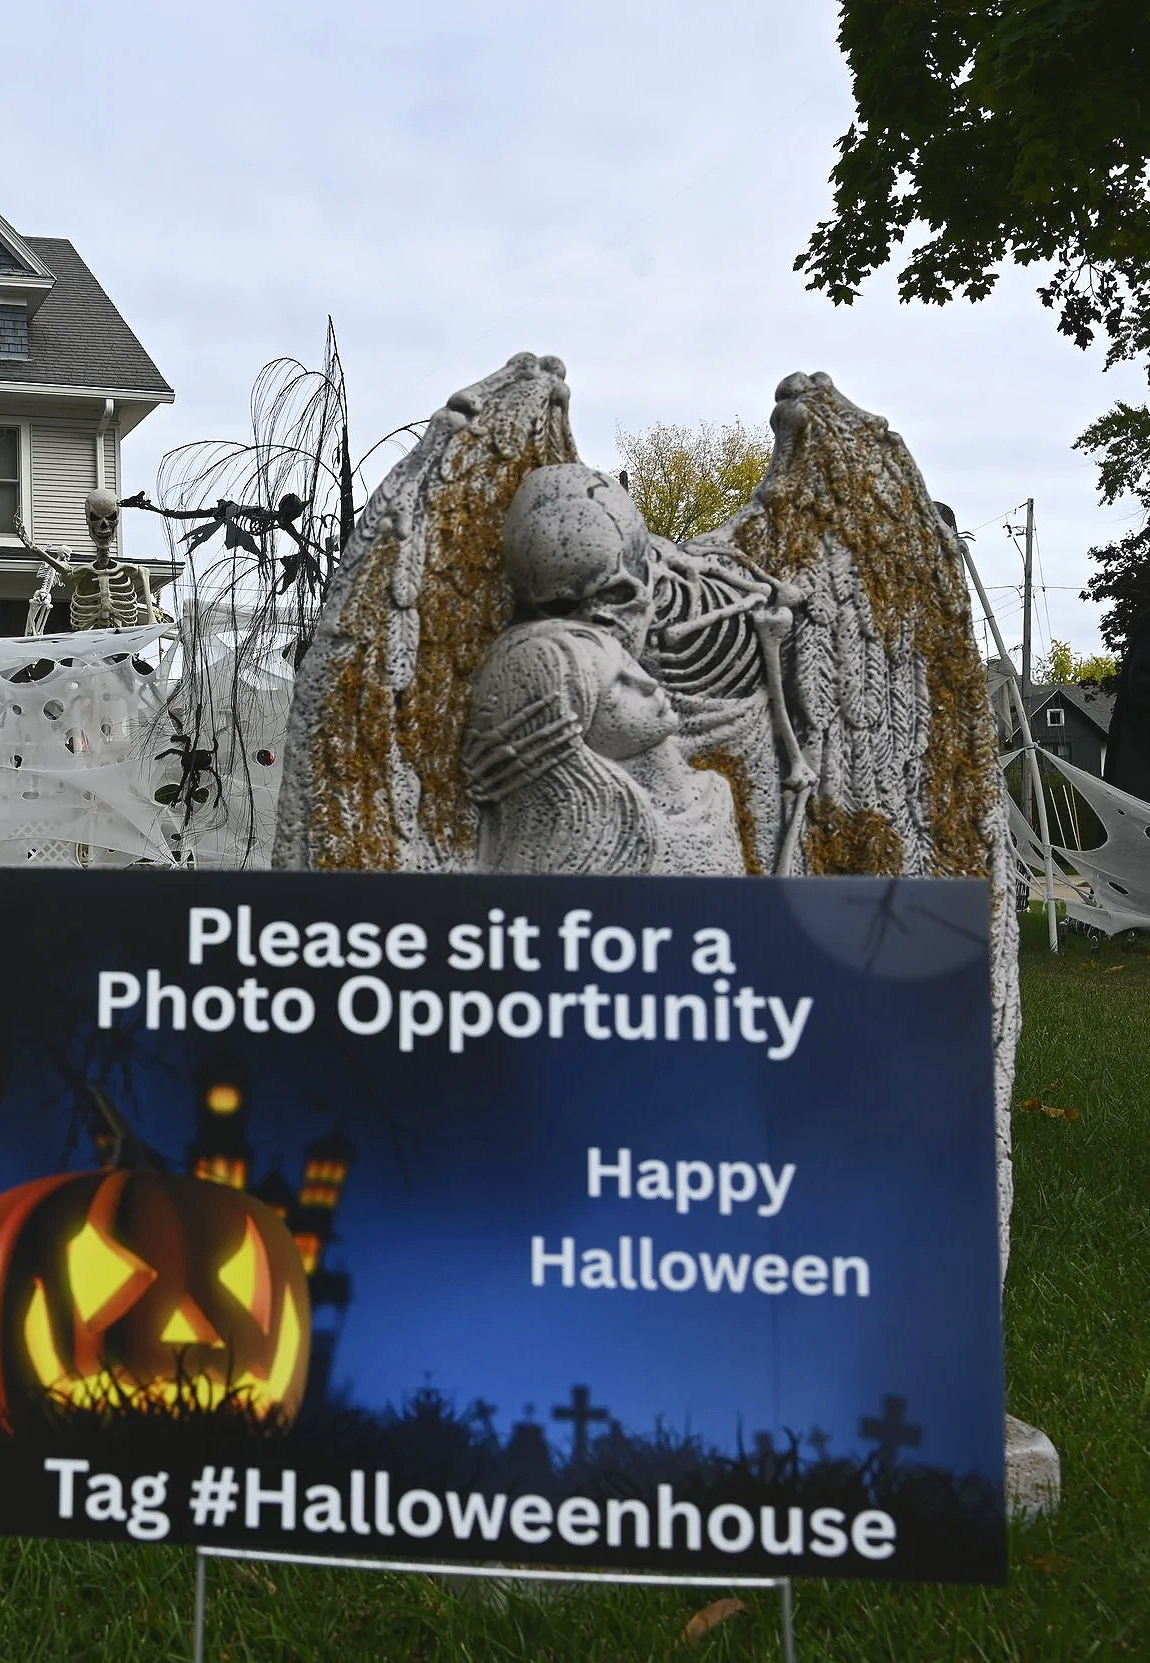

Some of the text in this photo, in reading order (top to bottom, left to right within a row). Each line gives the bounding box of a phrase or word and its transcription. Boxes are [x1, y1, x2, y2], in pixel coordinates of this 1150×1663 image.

[188, 905, 737, 974] Please sit for a
[97, 968, 813, 1061] Photo Opportunity
[588, 1147, 796, 1217] Happy
[531, 1235, 870, 1297] Halloween
[44, 1458, 896, 1559] Tag #Halloweenhouse
